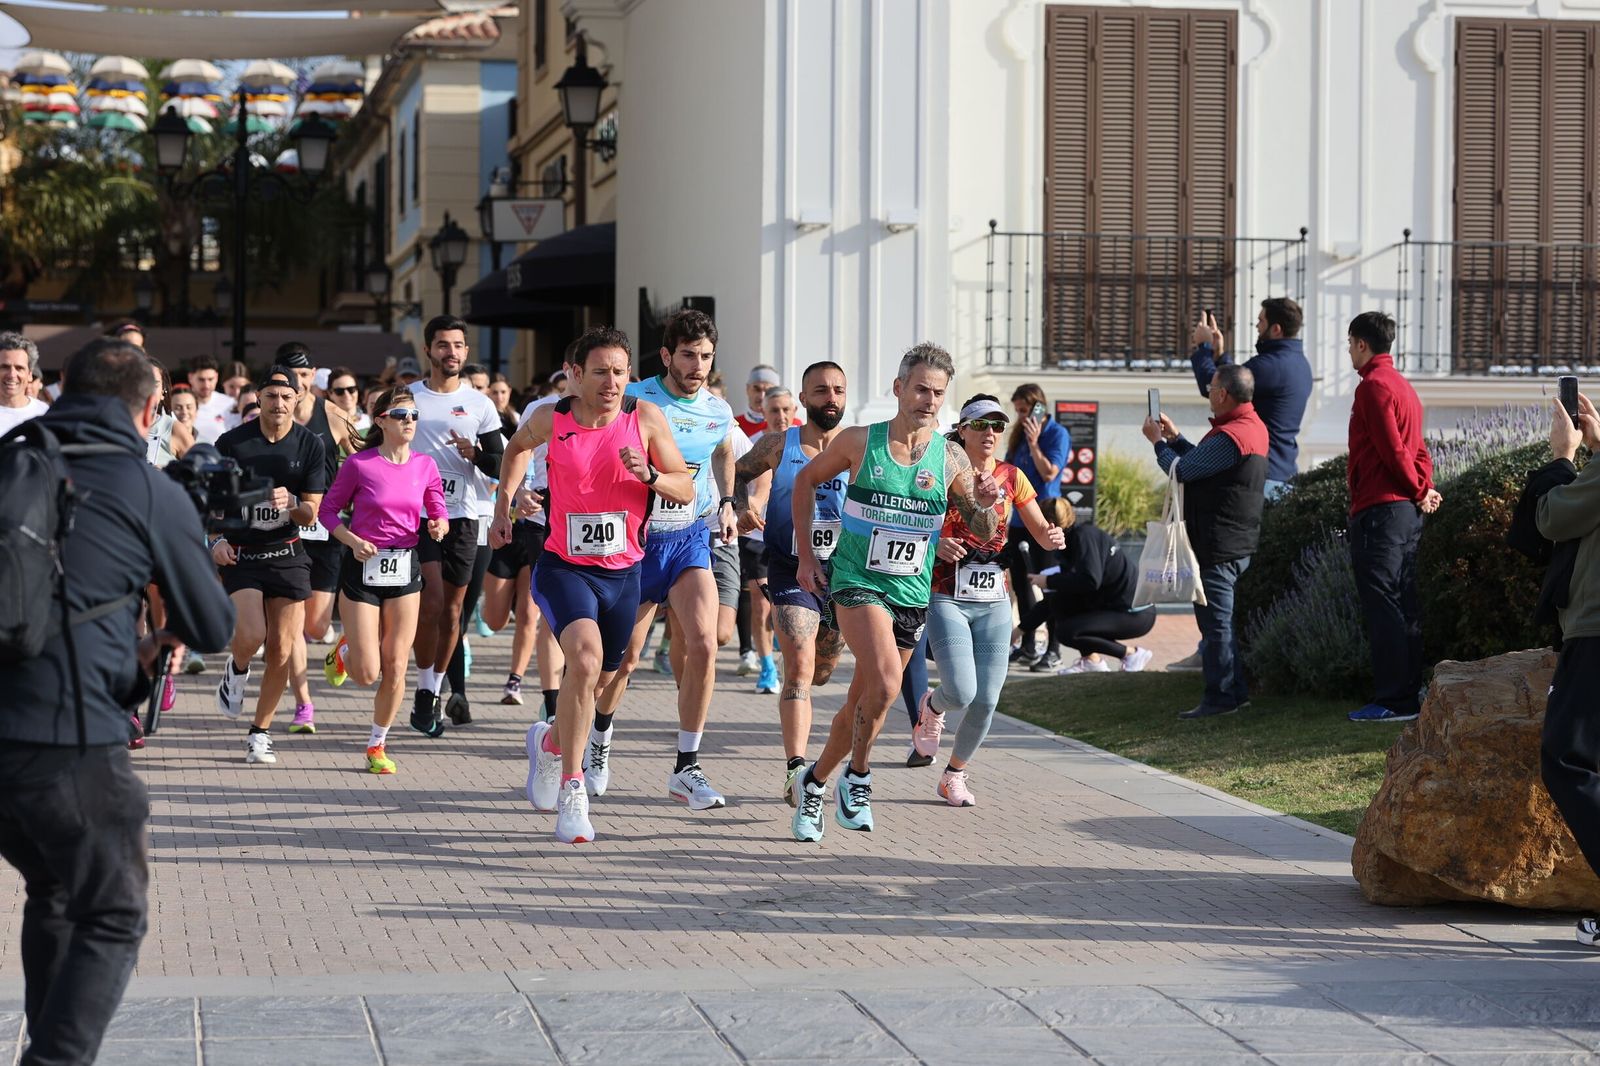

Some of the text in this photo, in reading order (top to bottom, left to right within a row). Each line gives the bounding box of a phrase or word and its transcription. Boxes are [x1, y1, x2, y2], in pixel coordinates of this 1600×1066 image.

[870, 492, 928, 512] ATLETISMO
[255, 507, 280, 522] 108
[860, 506, 935, 528] TORREMOLINOS
[582, 522, 615, 543] 240
[811, 529, 833, 547] 69
[240, 548, 290, 561] WONG
[887, 540, 916, 561] 179
[380, 558, 398, 574] 84
[969, 571, 995, 589] 425
